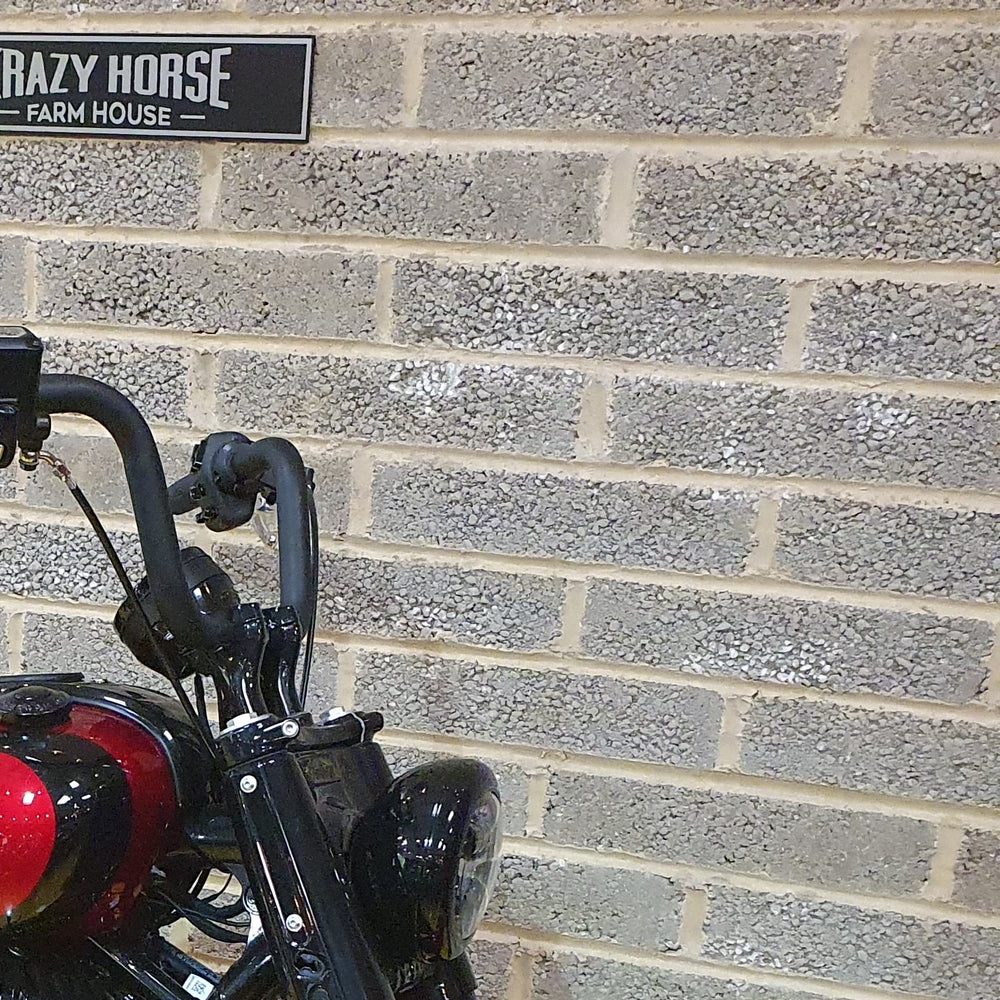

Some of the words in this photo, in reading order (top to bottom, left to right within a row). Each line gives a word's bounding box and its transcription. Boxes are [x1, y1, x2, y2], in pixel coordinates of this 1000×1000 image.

[108, 46, 232, 109] HORSE
[27, 101, 85, 123] FARM
[91, 101, 172, 126] HOUSE
